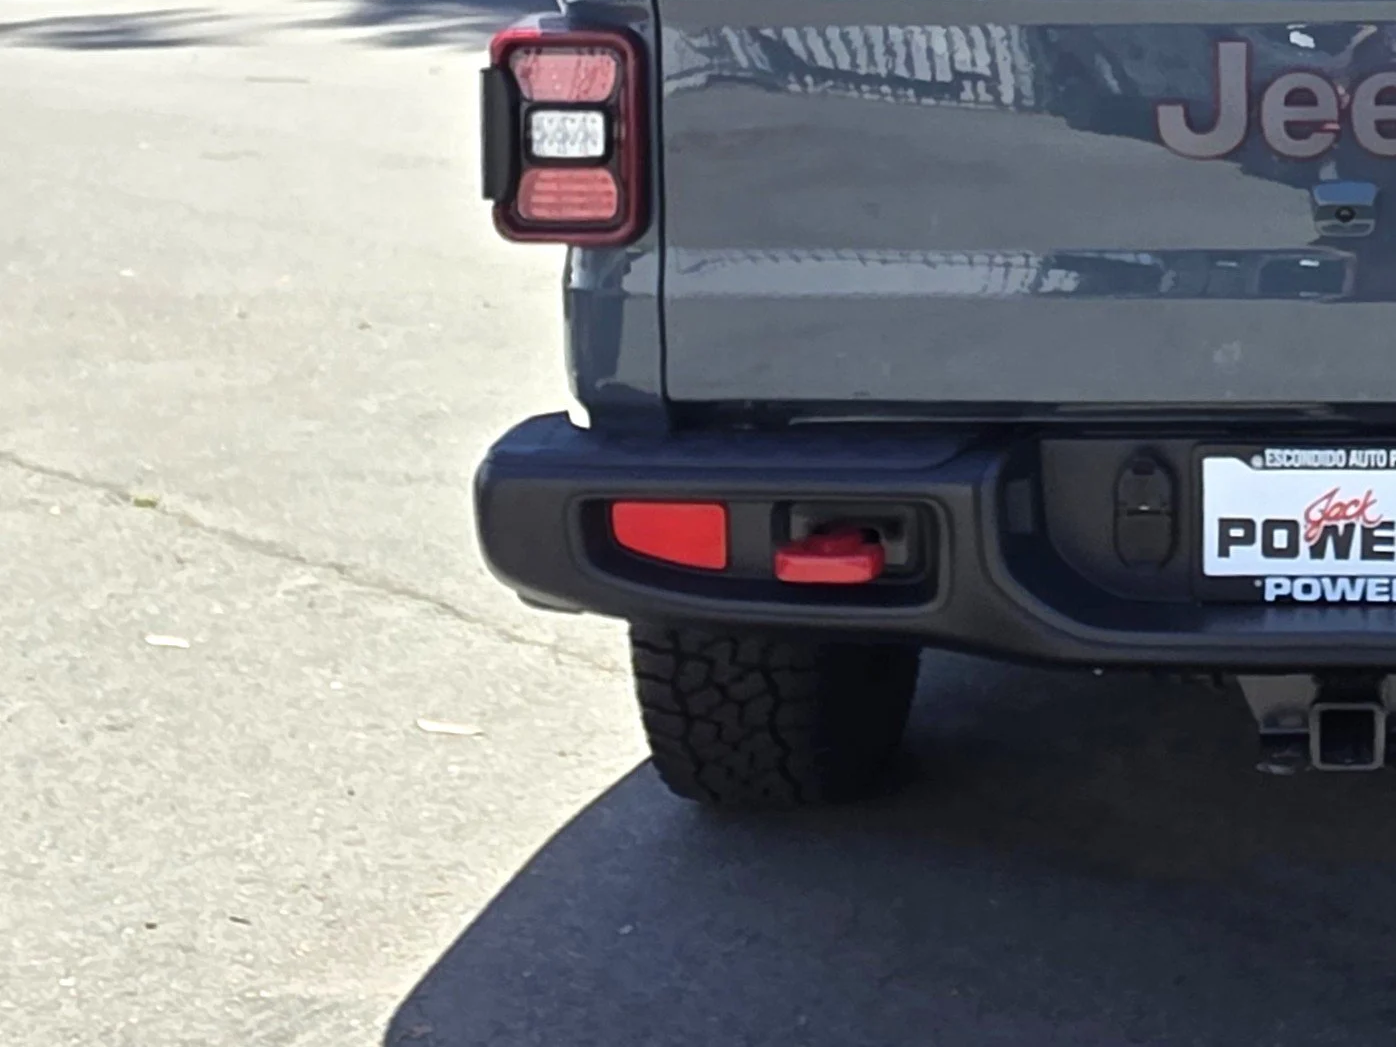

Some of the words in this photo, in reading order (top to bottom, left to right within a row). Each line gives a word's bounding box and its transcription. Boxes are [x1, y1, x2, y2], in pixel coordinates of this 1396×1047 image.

[1264, 449, 1346, 468] ESCONDIDO
[1349, 449, 1387, 468] AUTO
[1304, 486, 1383, 543] Jack
